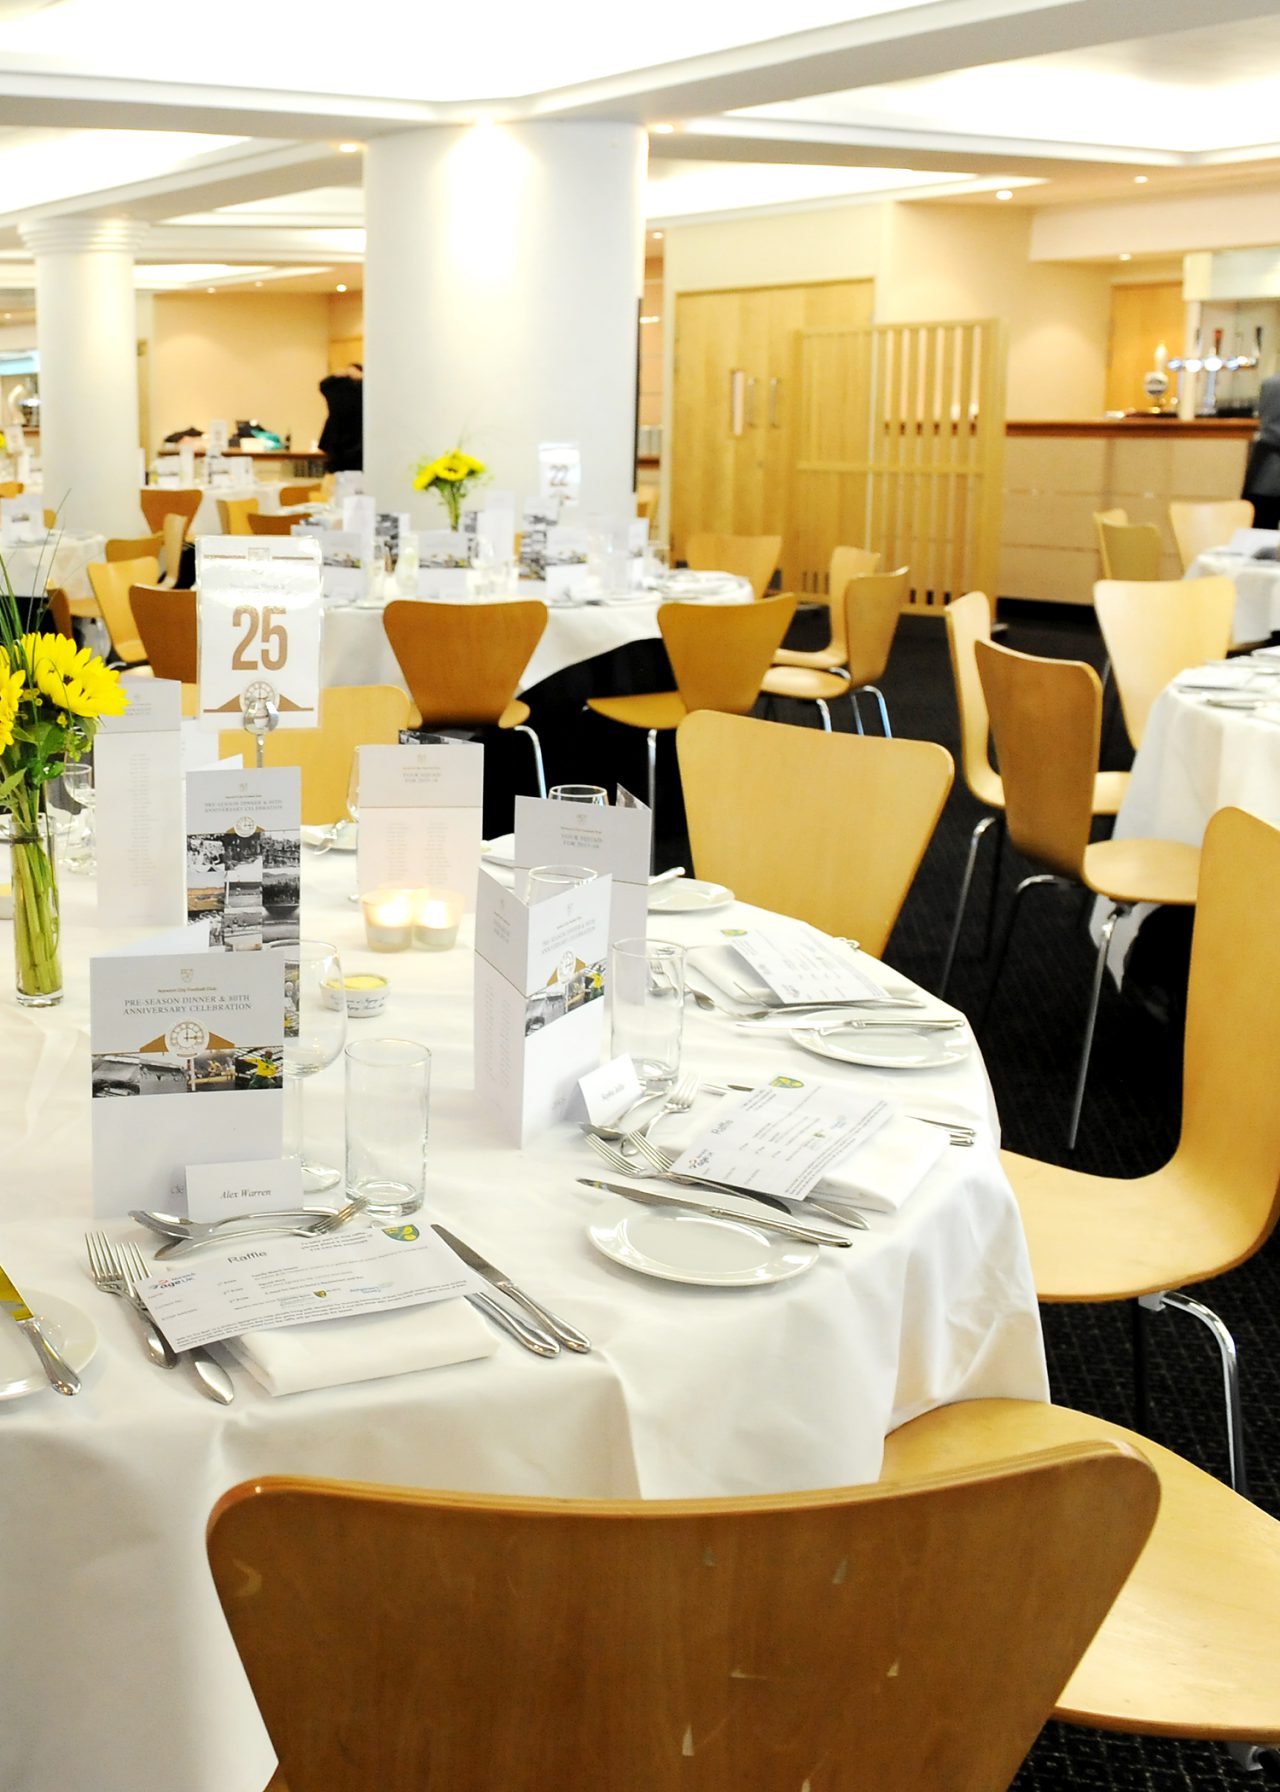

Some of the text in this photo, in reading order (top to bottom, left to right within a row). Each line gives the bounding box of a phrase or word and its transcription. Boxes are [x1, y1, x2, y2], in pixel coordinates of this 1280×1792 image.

[231, 604, 289, 671] 25
[124, 997, 180, 1007] PRE-SEASON
[181, 995, 217, 1004] DINNER
[218, 995, 226, 1003] &
[123, 1003, 252, 1016] ANNIVERSARY CELEBRATION
[220, 1188, 272, 1199] Alex Warren
[227, 1250, 268, 1264] Raffle
